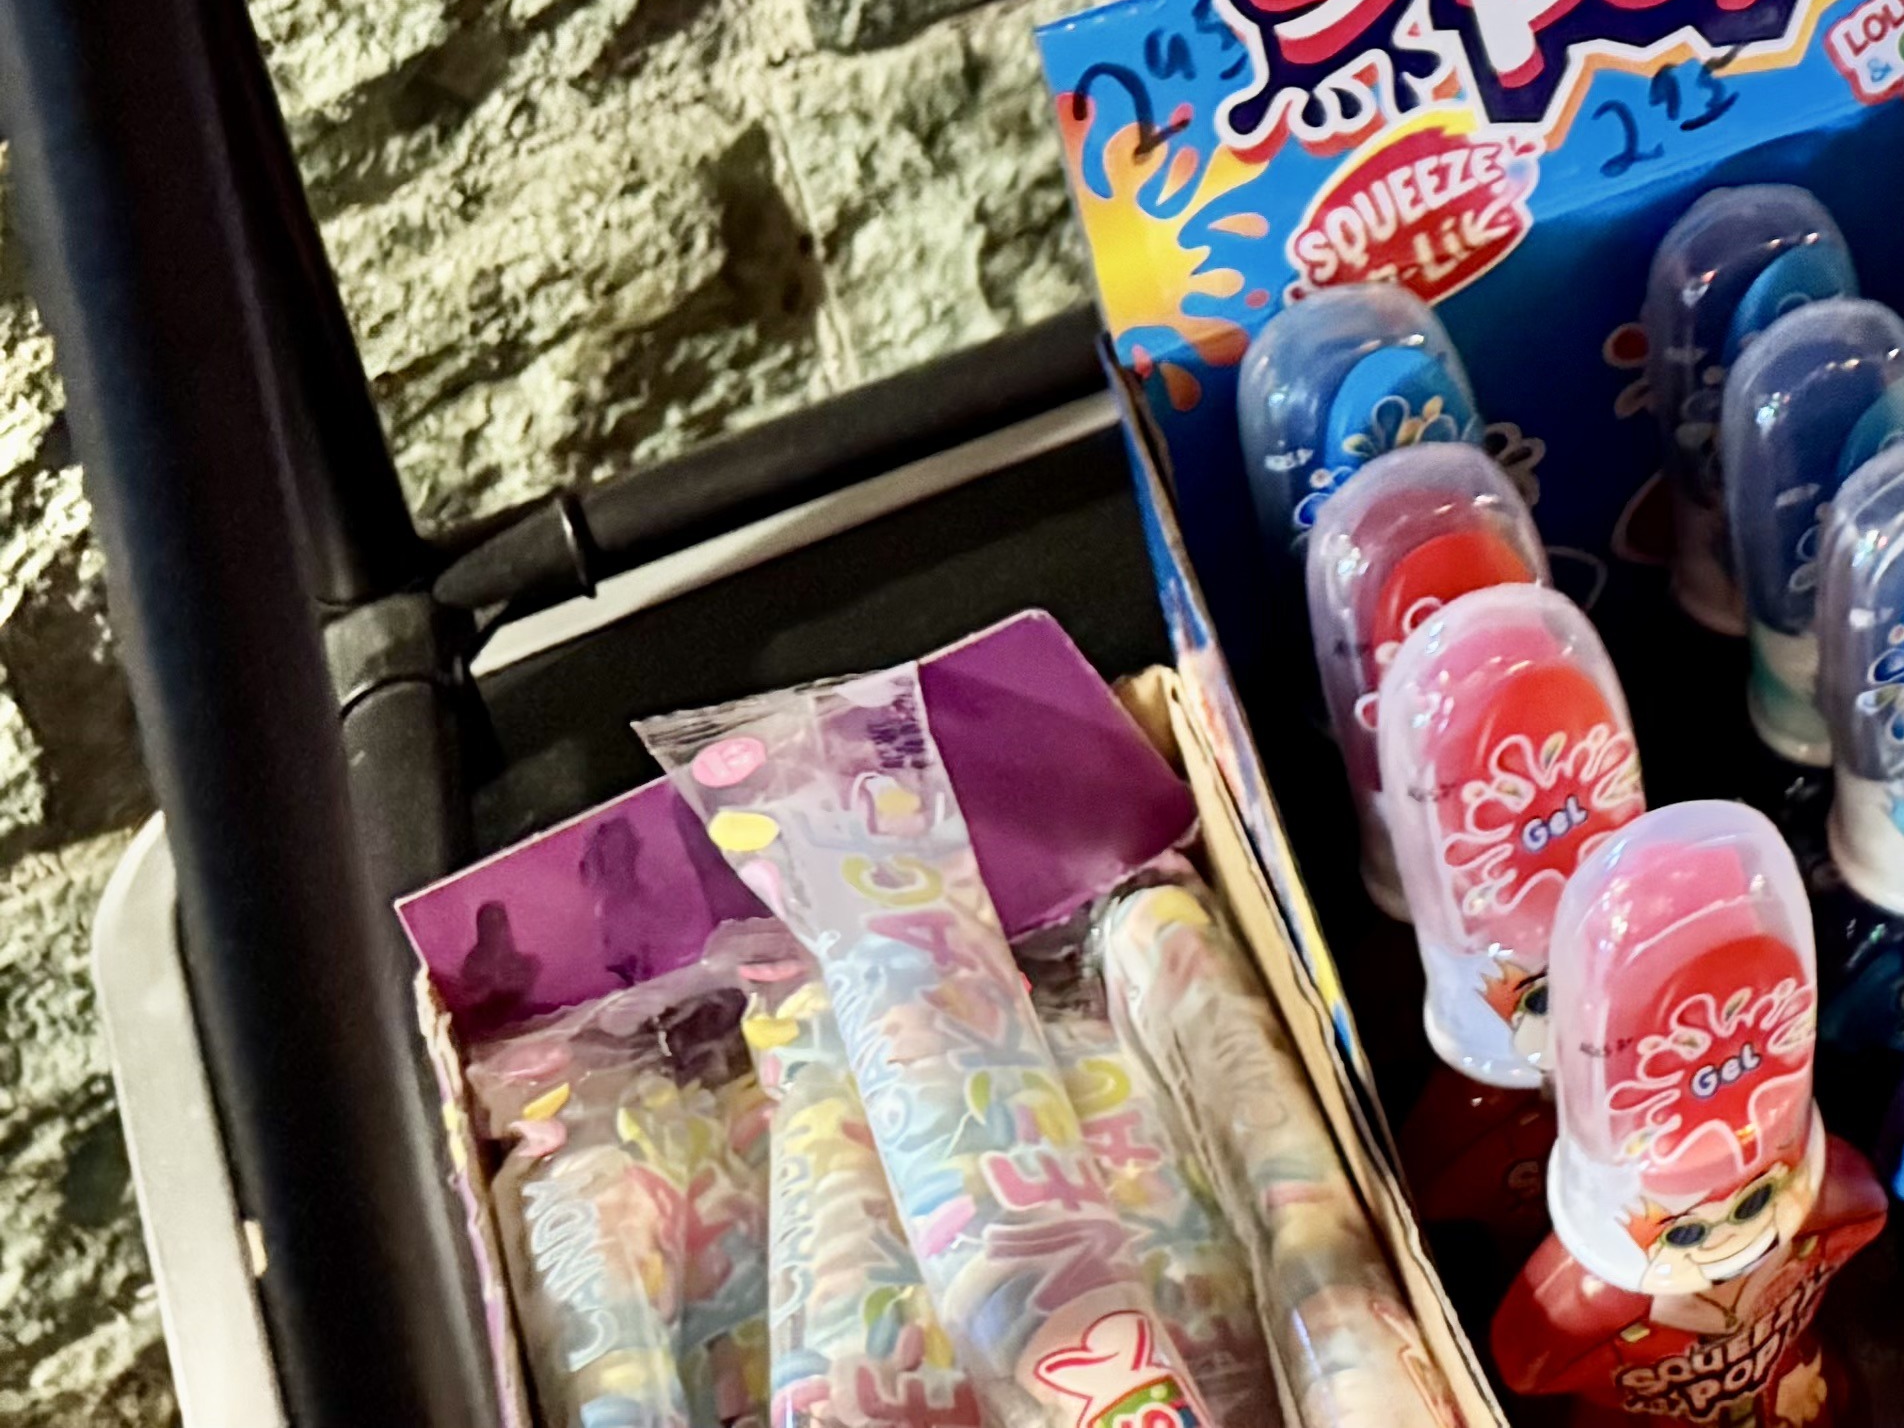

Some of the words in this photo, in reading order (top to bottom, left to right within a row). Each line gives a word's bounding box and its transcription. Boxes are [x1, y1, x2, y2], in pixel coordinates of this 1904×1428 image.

[1867, 58, 1891, 83] &
[1297, 145, 1506, 282] SQUEEZE
[1686, 1333, 1783, 1412] POP
